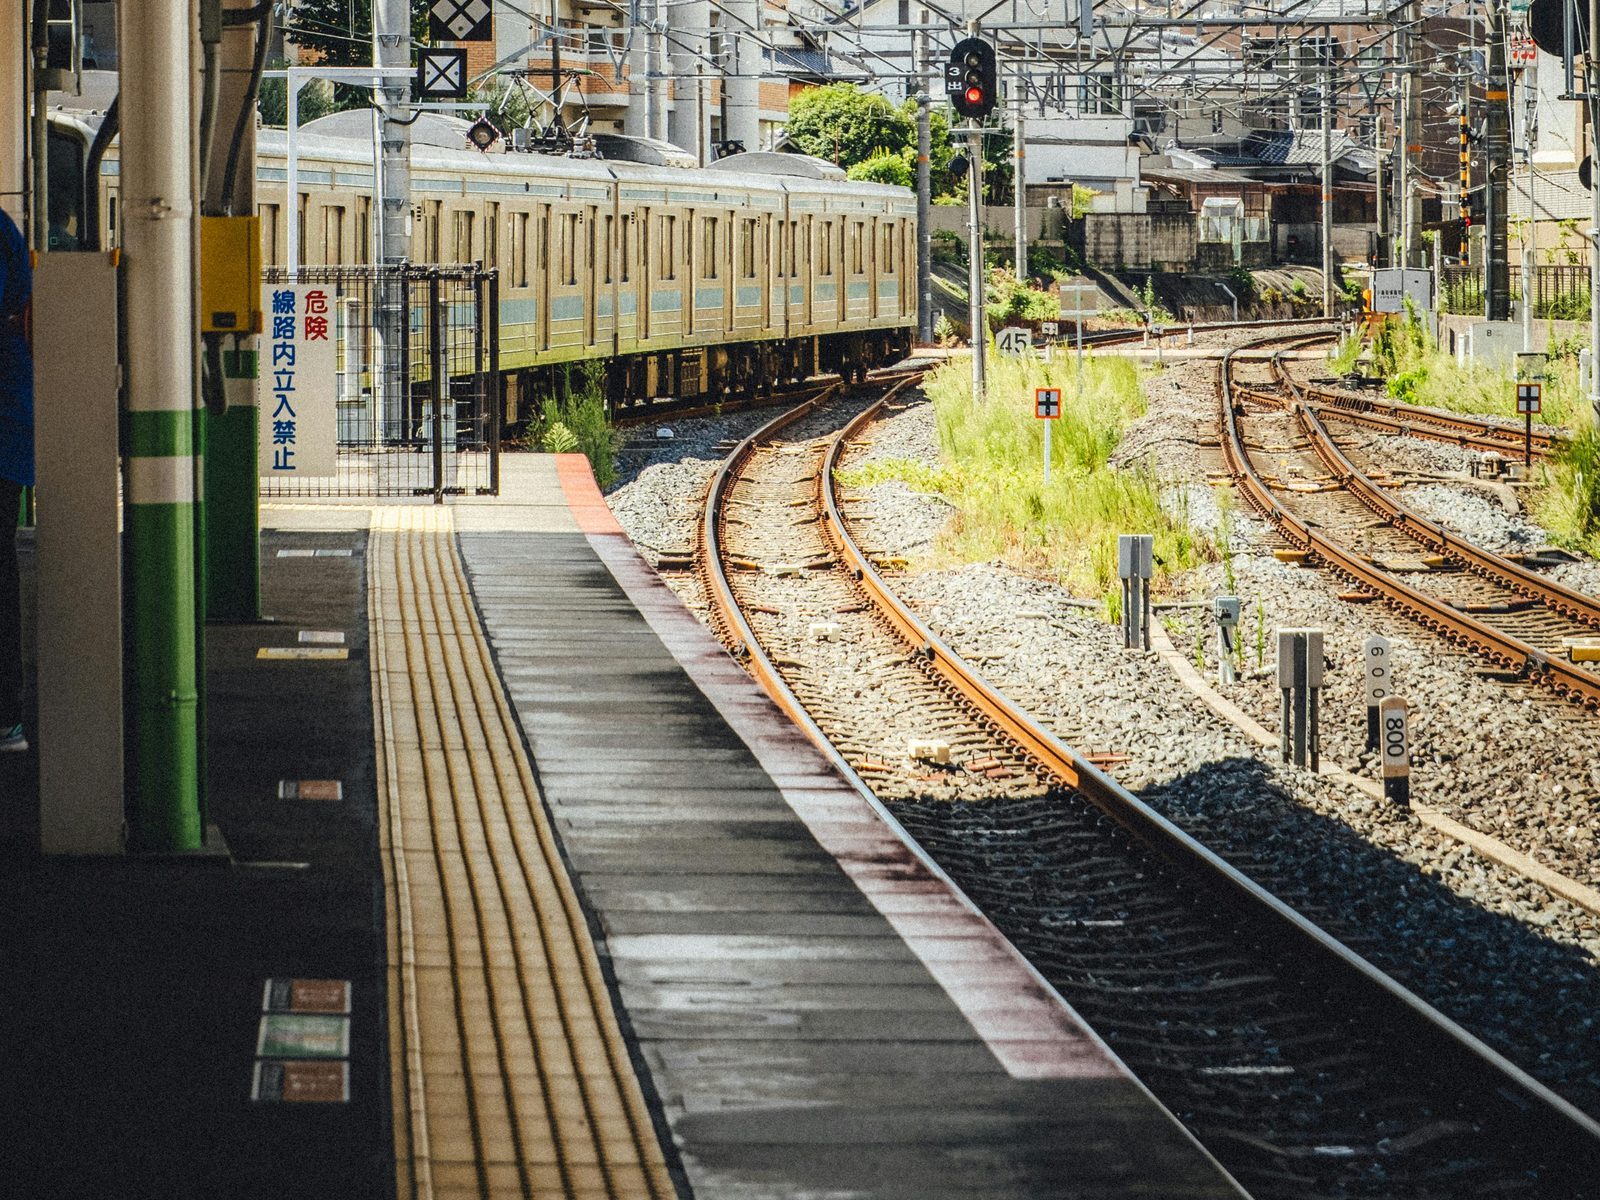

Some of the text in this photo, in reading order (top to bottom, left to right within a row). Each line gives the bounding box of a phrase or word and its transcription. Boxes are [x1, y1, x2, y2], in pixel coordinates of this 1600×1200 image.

[948, 66, 960, 76] 3
[305, 290, 328, 341] 危険
[999, 332, 1027, 353] 45
[272, 289, 296, 470] 線路内立入禁止
[1386, 717, 1405, 757] 800
